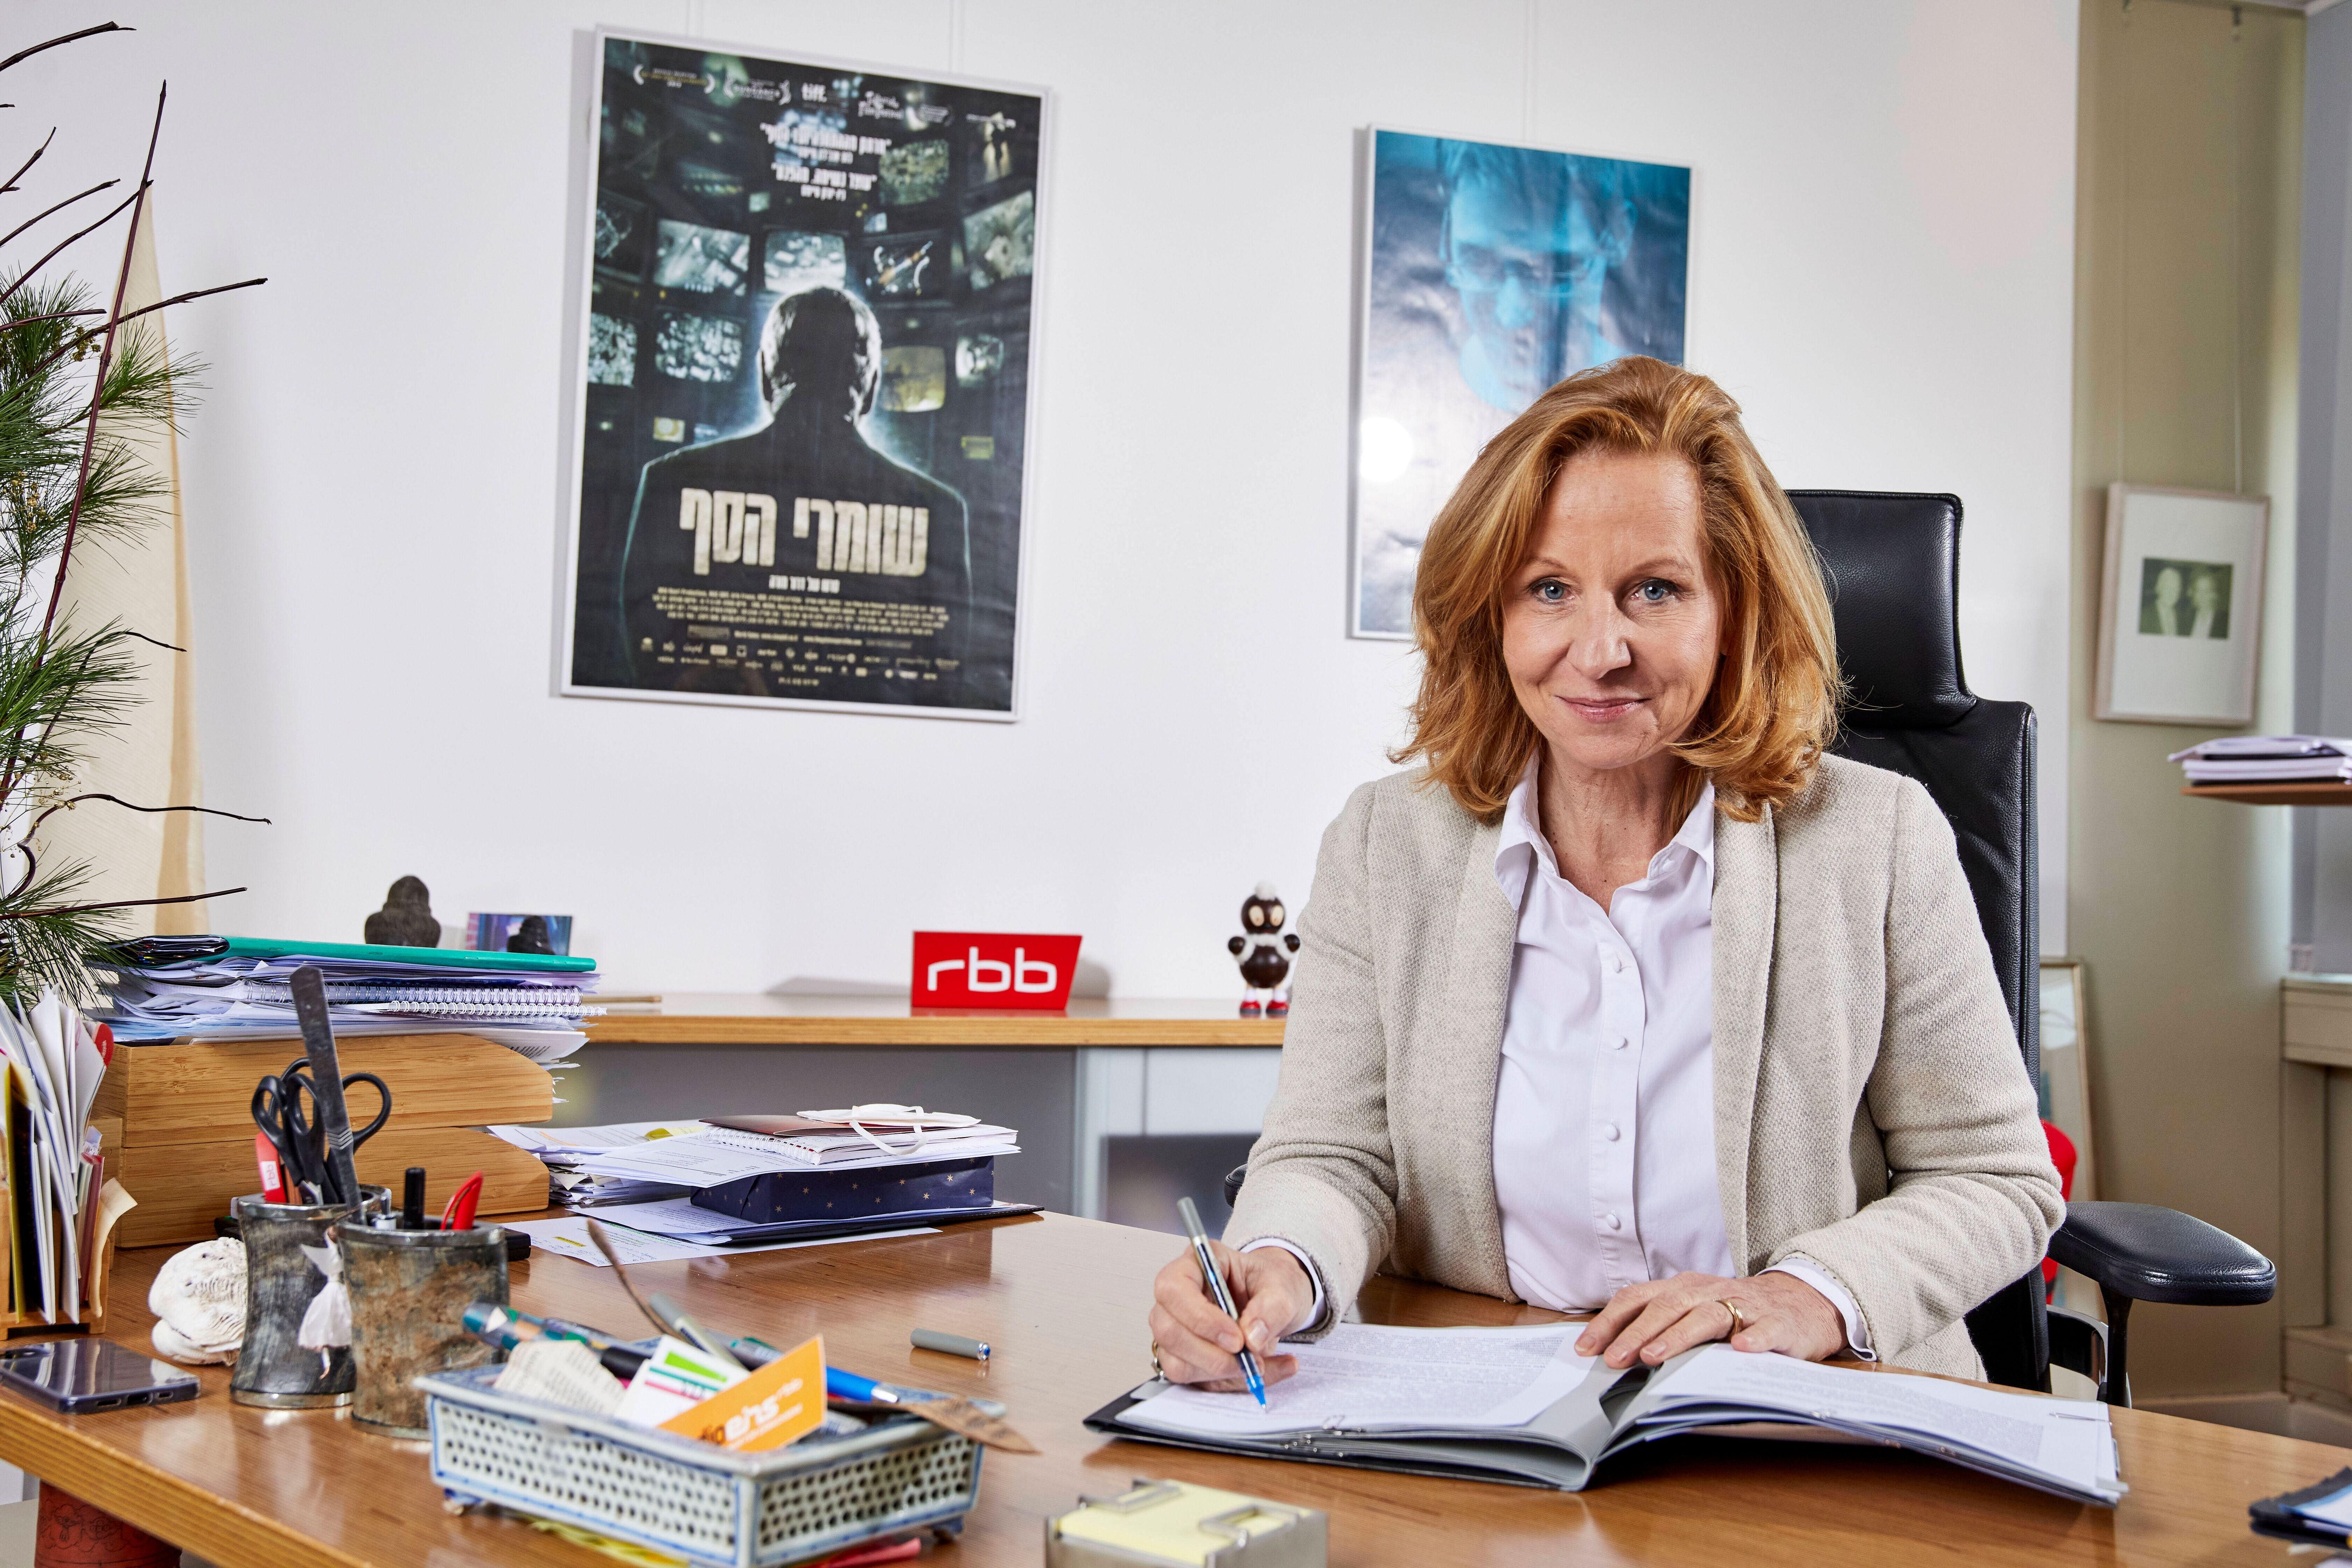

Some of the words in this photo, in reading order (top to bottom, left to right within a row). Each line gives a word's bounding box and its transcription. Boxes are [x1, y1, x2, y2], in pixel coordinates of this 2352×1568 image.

[679, 487, 777, 575] הסף
[793, 497, 929, 577] שומרי
[927, 946, 1058, 993] rbb
[267, 1164, 277, 1187] rbb
